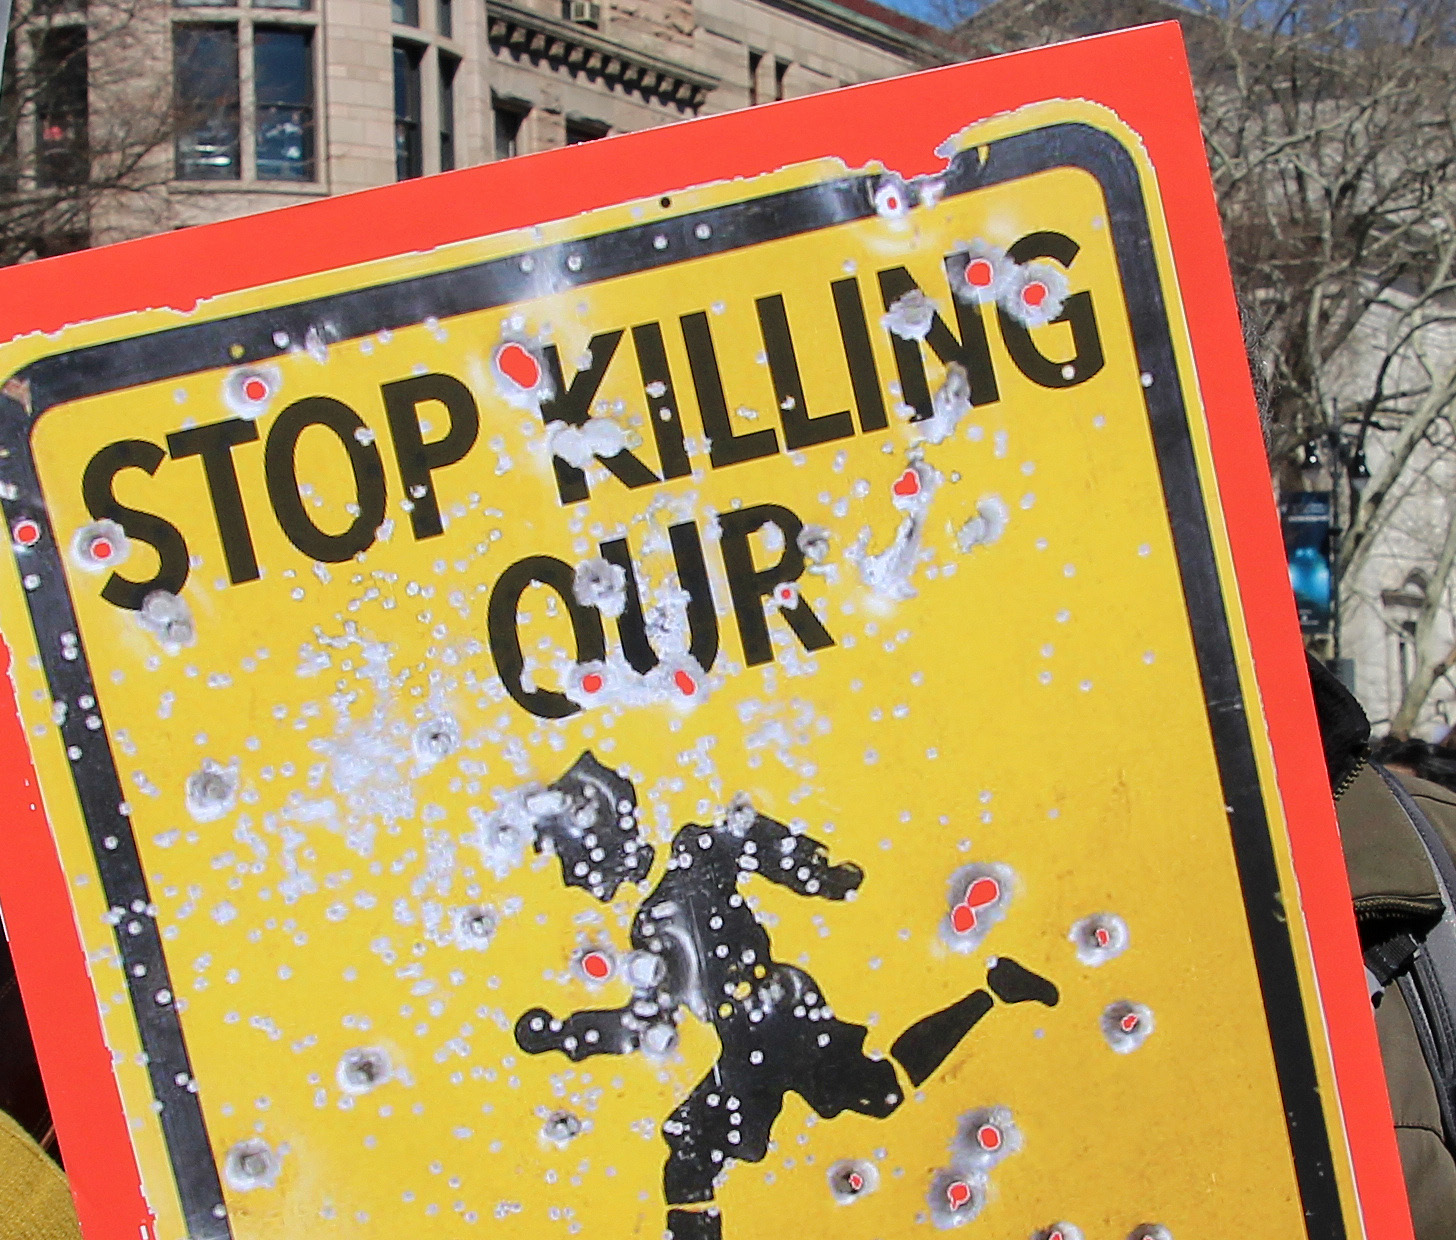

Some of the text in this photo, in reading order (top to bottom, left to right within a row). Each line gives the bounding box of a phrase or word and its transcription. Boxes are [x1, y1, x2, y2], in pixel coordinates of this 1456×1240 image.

[82, 231, 1105, 611] STOP KILLING
[487, 503, 836, 719] OUR
